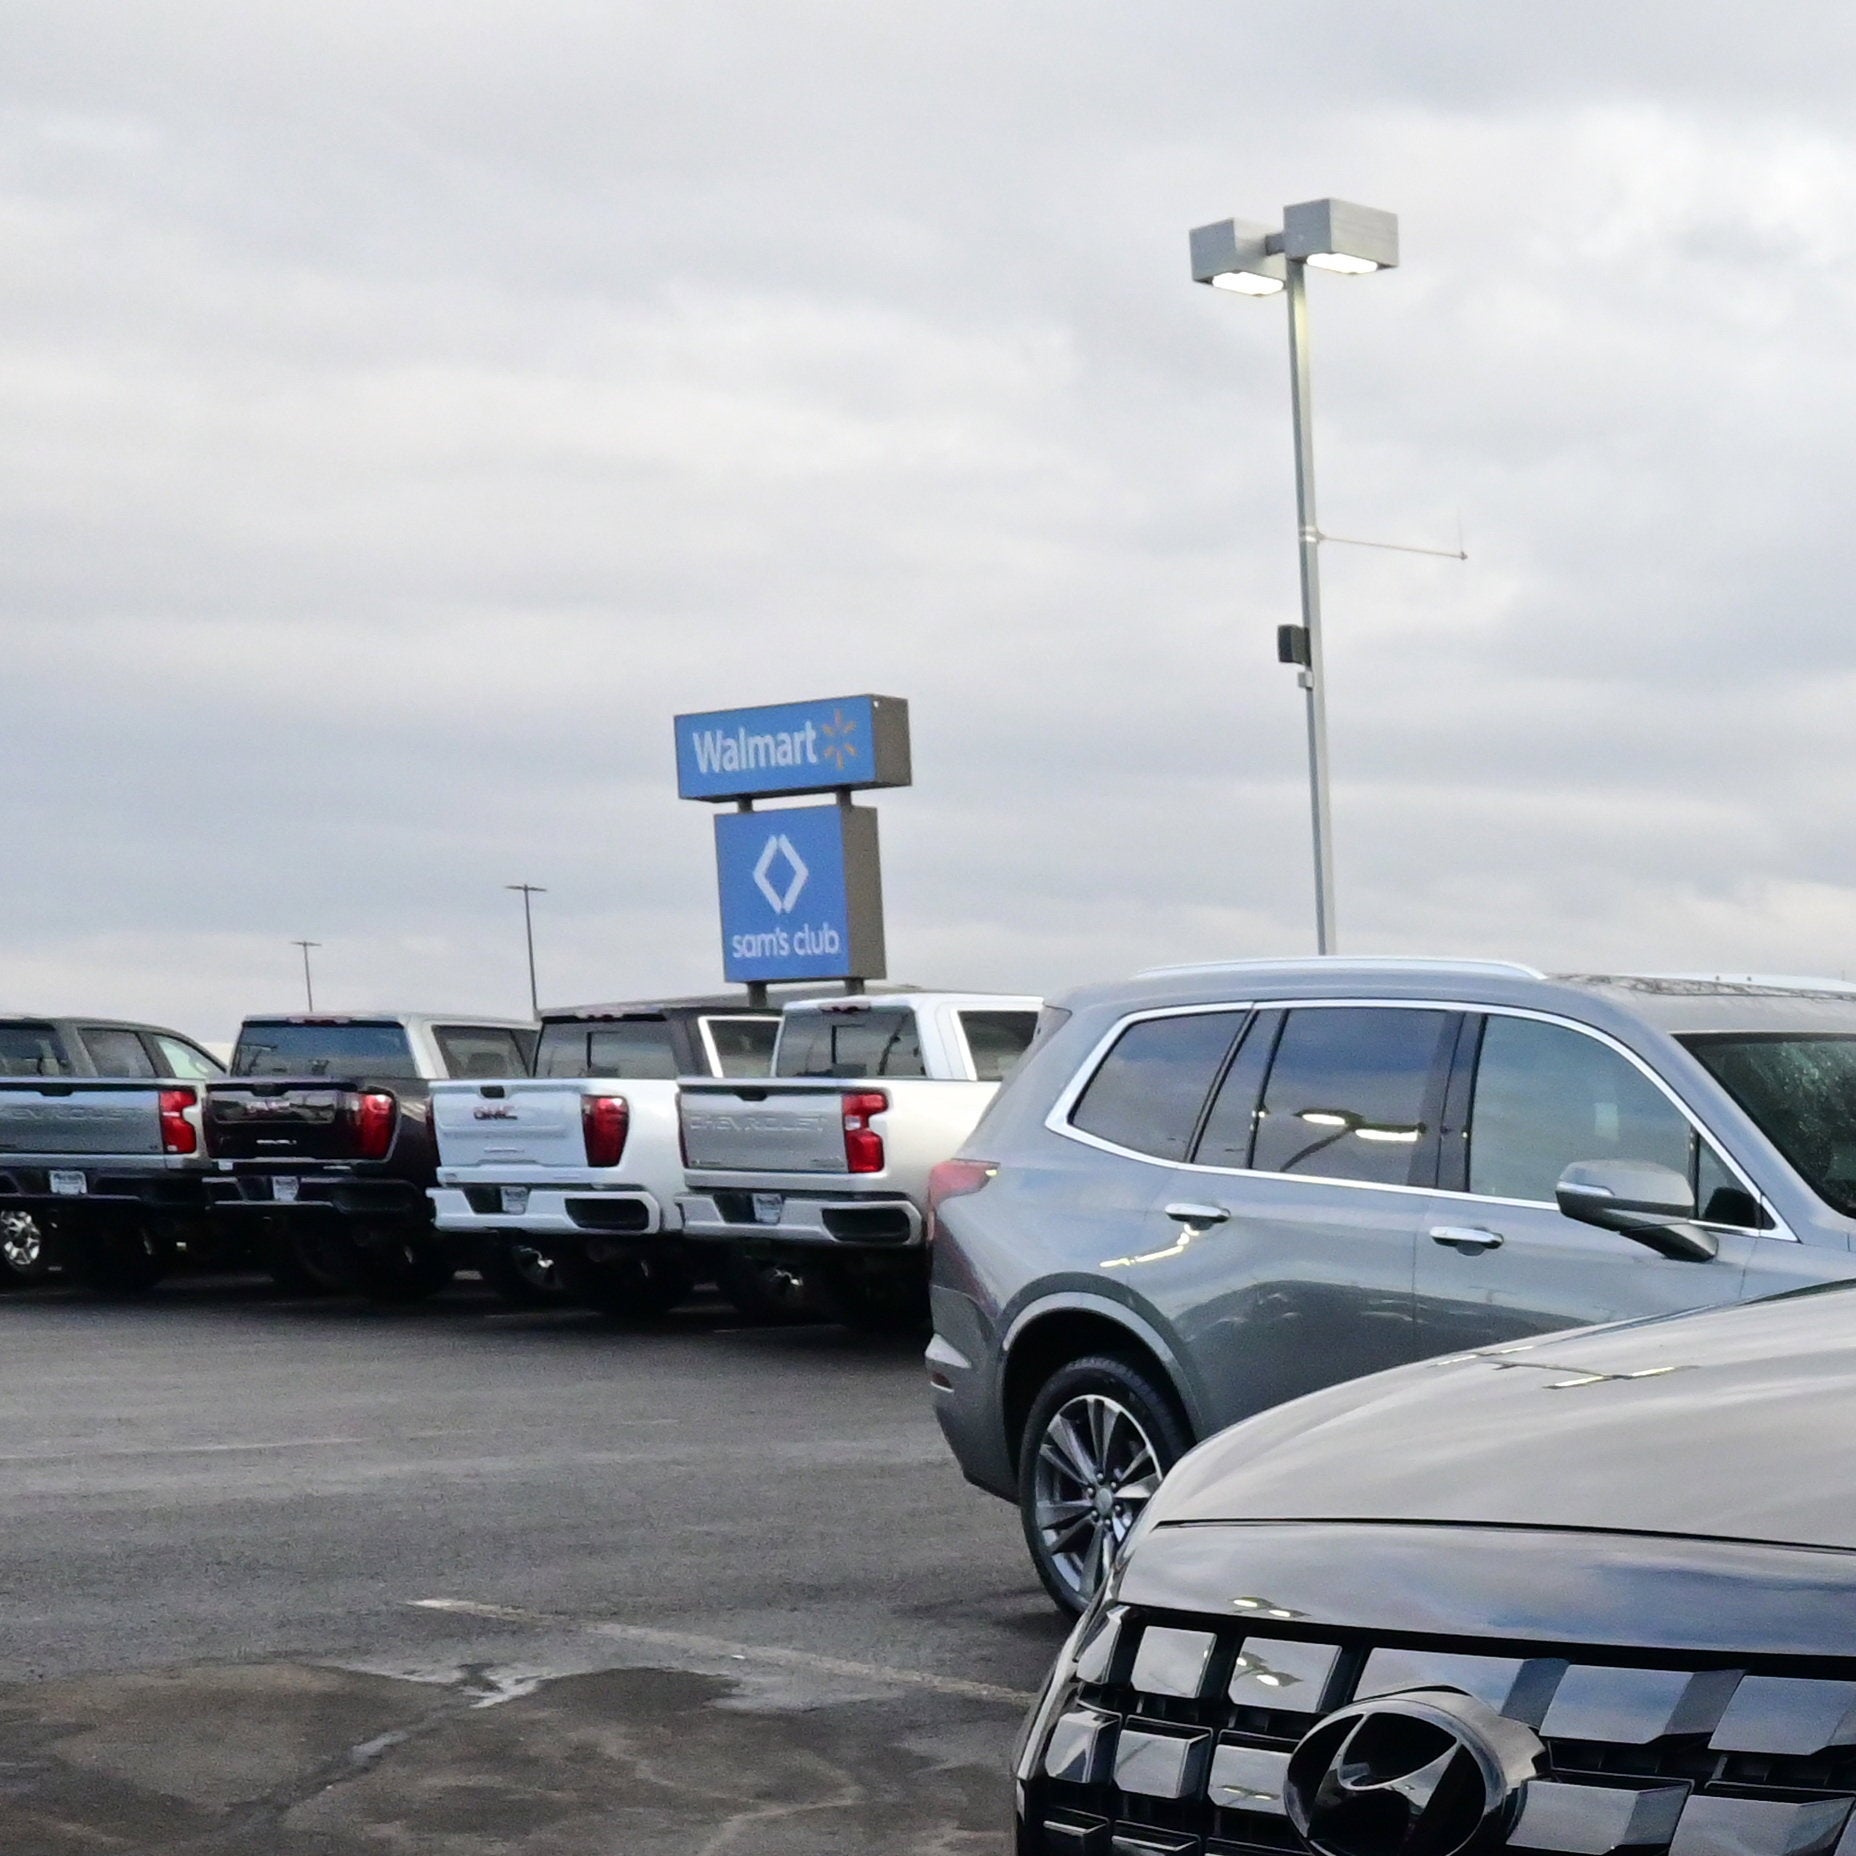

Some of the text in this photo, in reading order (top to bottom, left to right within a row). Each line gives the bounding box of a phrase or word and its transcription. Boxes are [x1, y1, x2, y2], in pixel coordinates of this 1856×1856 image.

[692, 720, 818, 775] Walmart
[732, 922, 841, 959] sam's club
